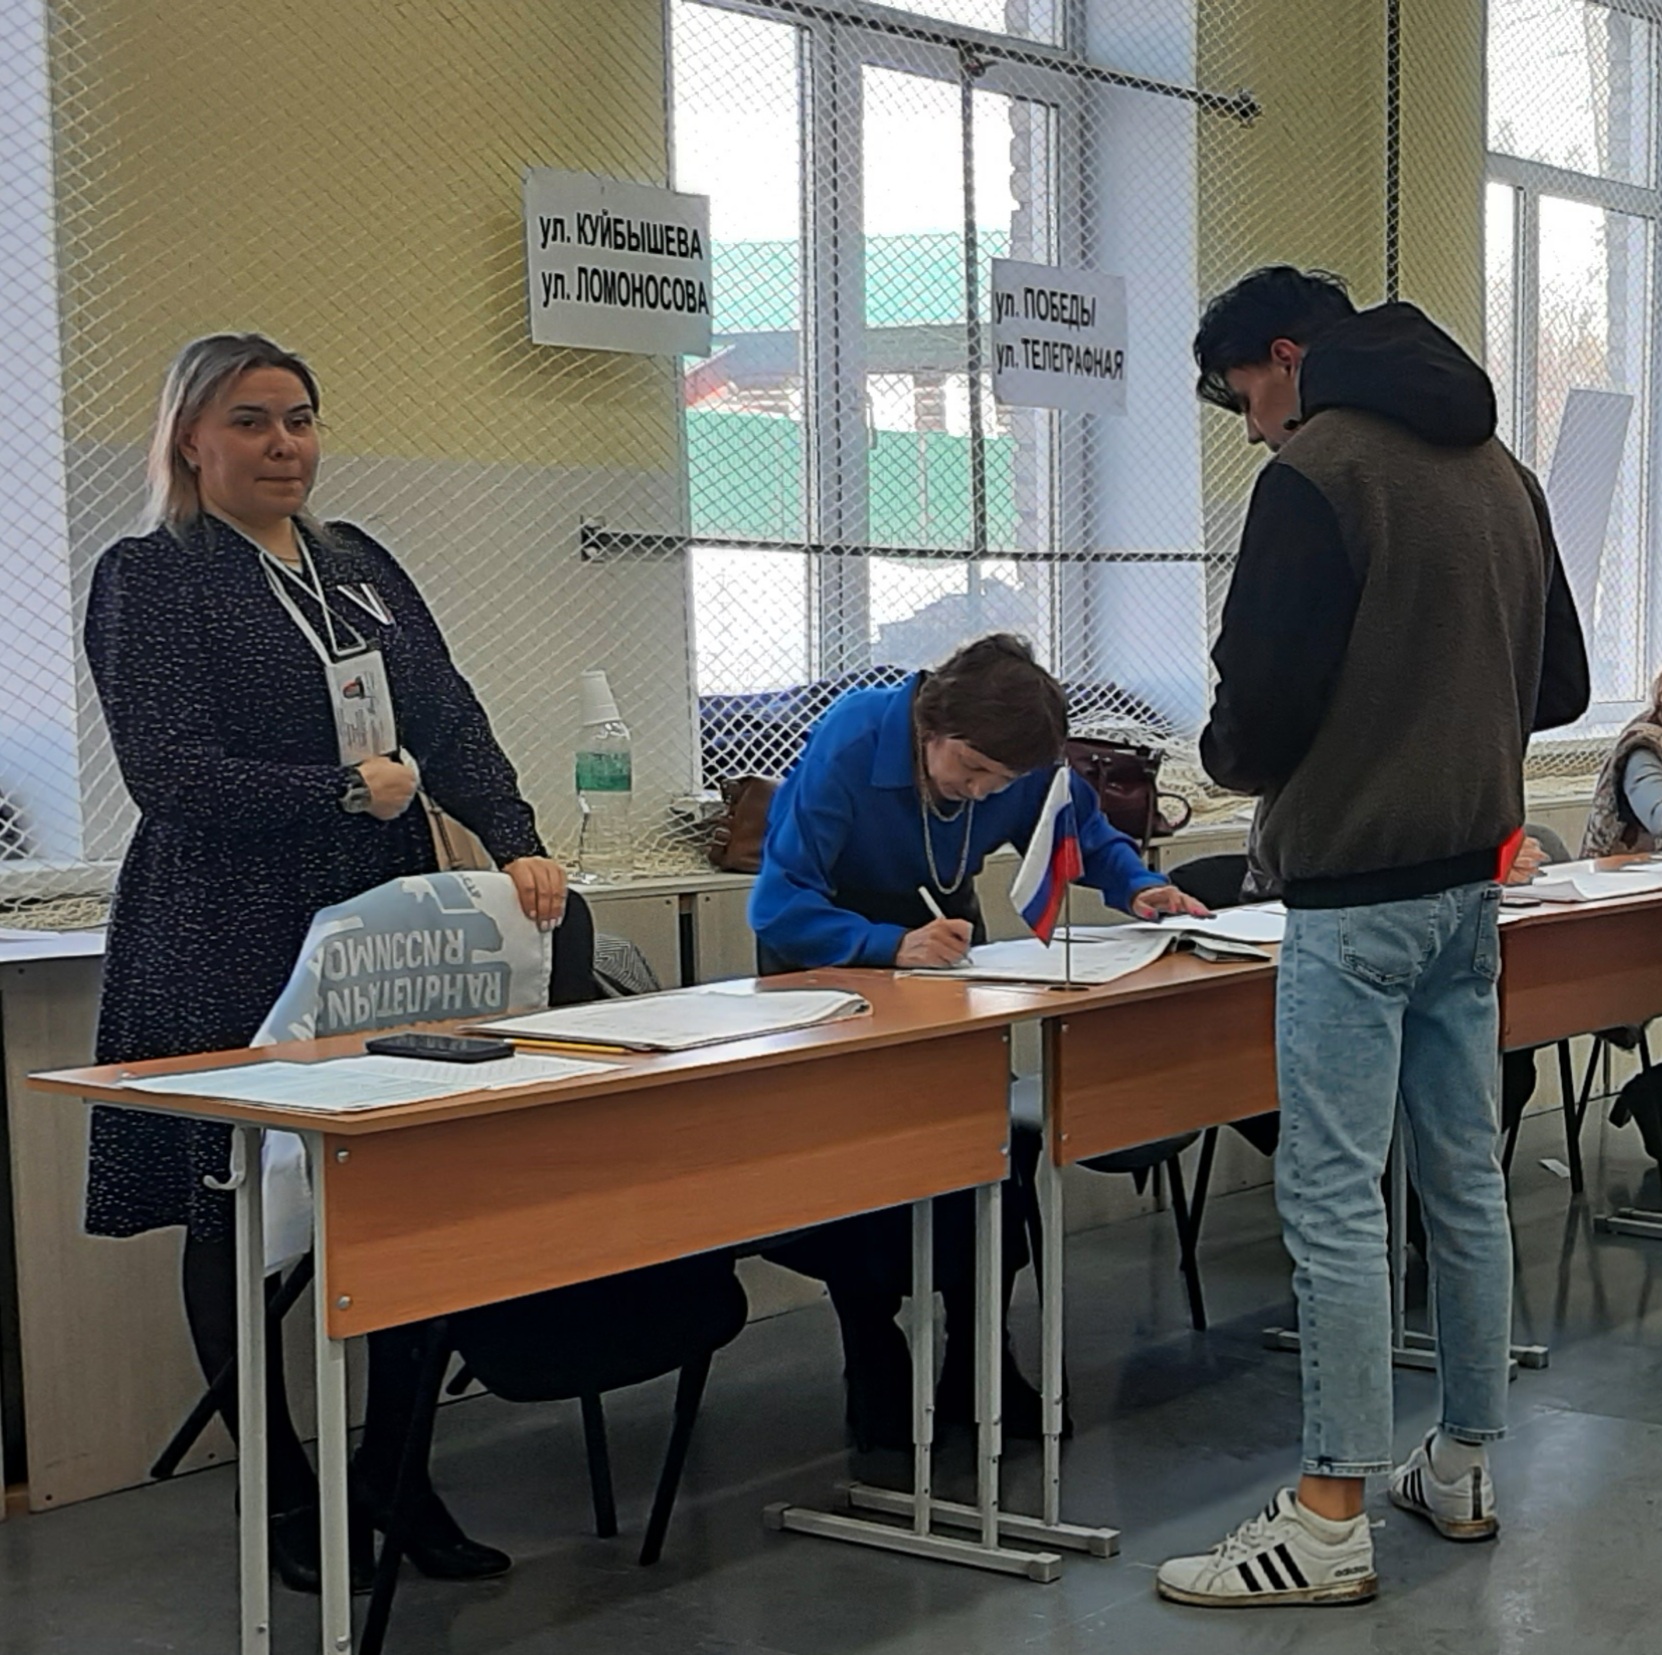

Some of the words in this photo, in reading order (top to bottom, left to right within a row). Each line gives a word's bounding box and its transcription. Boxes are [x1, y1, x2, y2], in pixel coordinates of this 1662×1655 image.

[539, 215, 571, 249] ул.
[576, 208, 703, 260] КУЙБЫШЕВА
[541, 271, 571, 308] ул.
[576, 266, 710, 315] ЛОМОНОСОВА
[995, 291, 1019, 325] ул.
[1024, 286, 1096, 332] ПОБЕДЫ
[996, 342, 1019, 375] ул.
[1021, 337, 1125, 381] ТЕЛЕГРАФНАЯ
